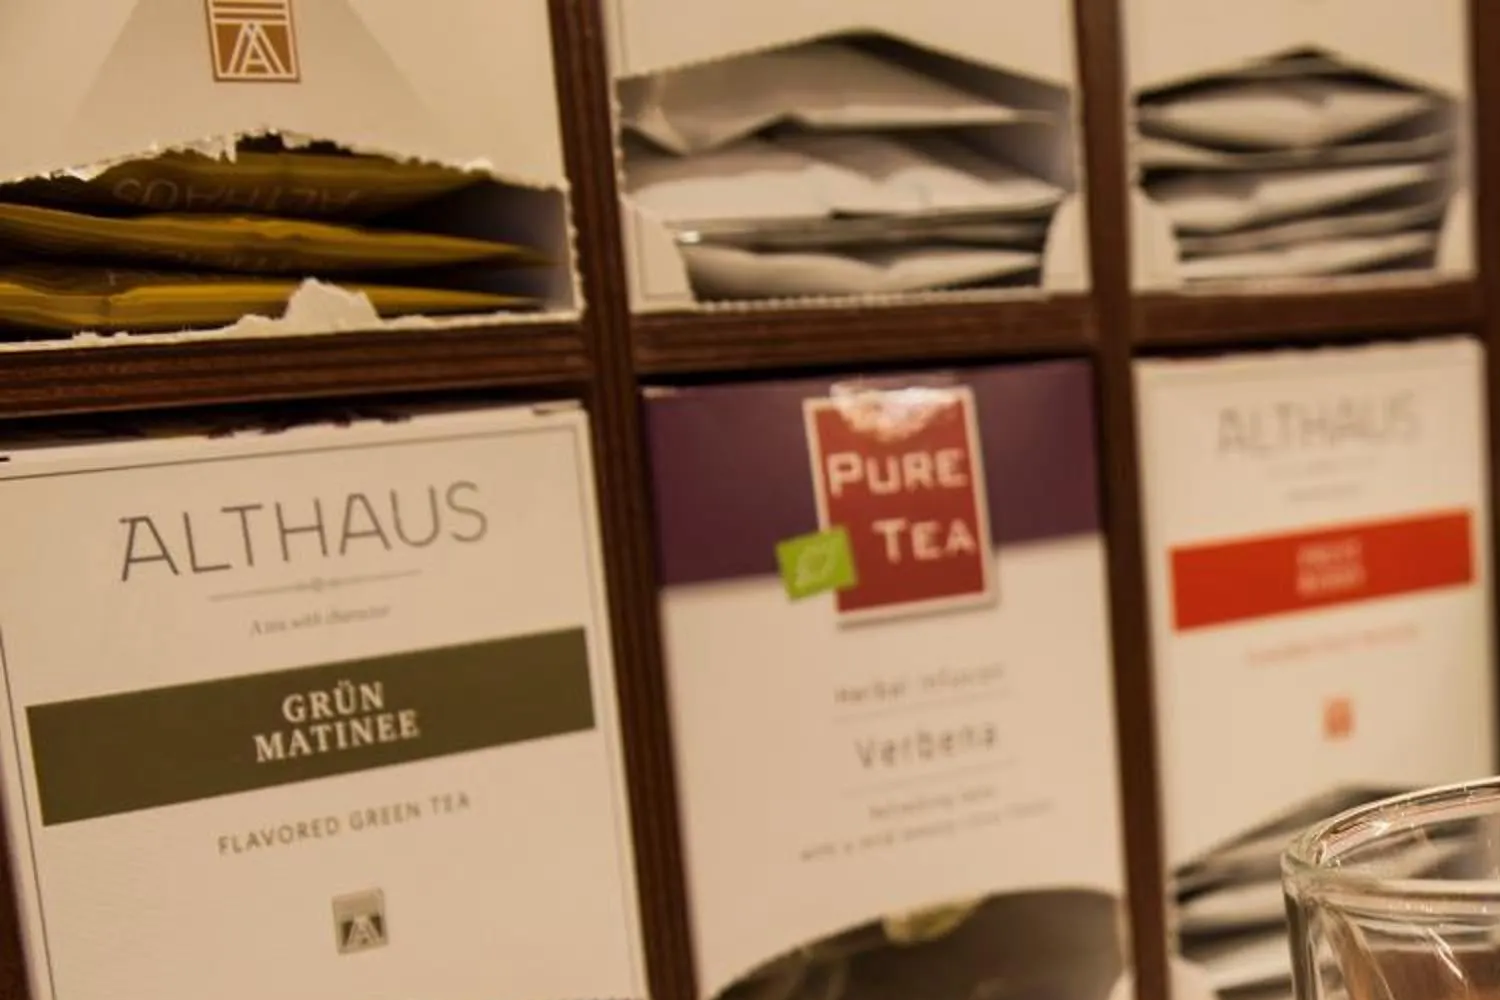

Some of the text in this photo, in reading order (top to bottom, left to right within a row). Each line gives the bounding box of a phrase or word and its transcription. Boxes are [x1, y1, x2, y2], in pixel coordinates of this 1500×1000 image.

[1216, 389, 1423, 457] ALTHAUS
[826, 447, 968, 499] PURE
[118, 480, 490, 582] ALTHAUS
[872, 517, 979, 564] TEA
[282, 679, 386, 724] GRÜN
[252, 709, 421, 763] MATINEE
[853, 720, 999, 770] Verbena
[216, 790, 470, 855] FLAVORED GREEN TEA
